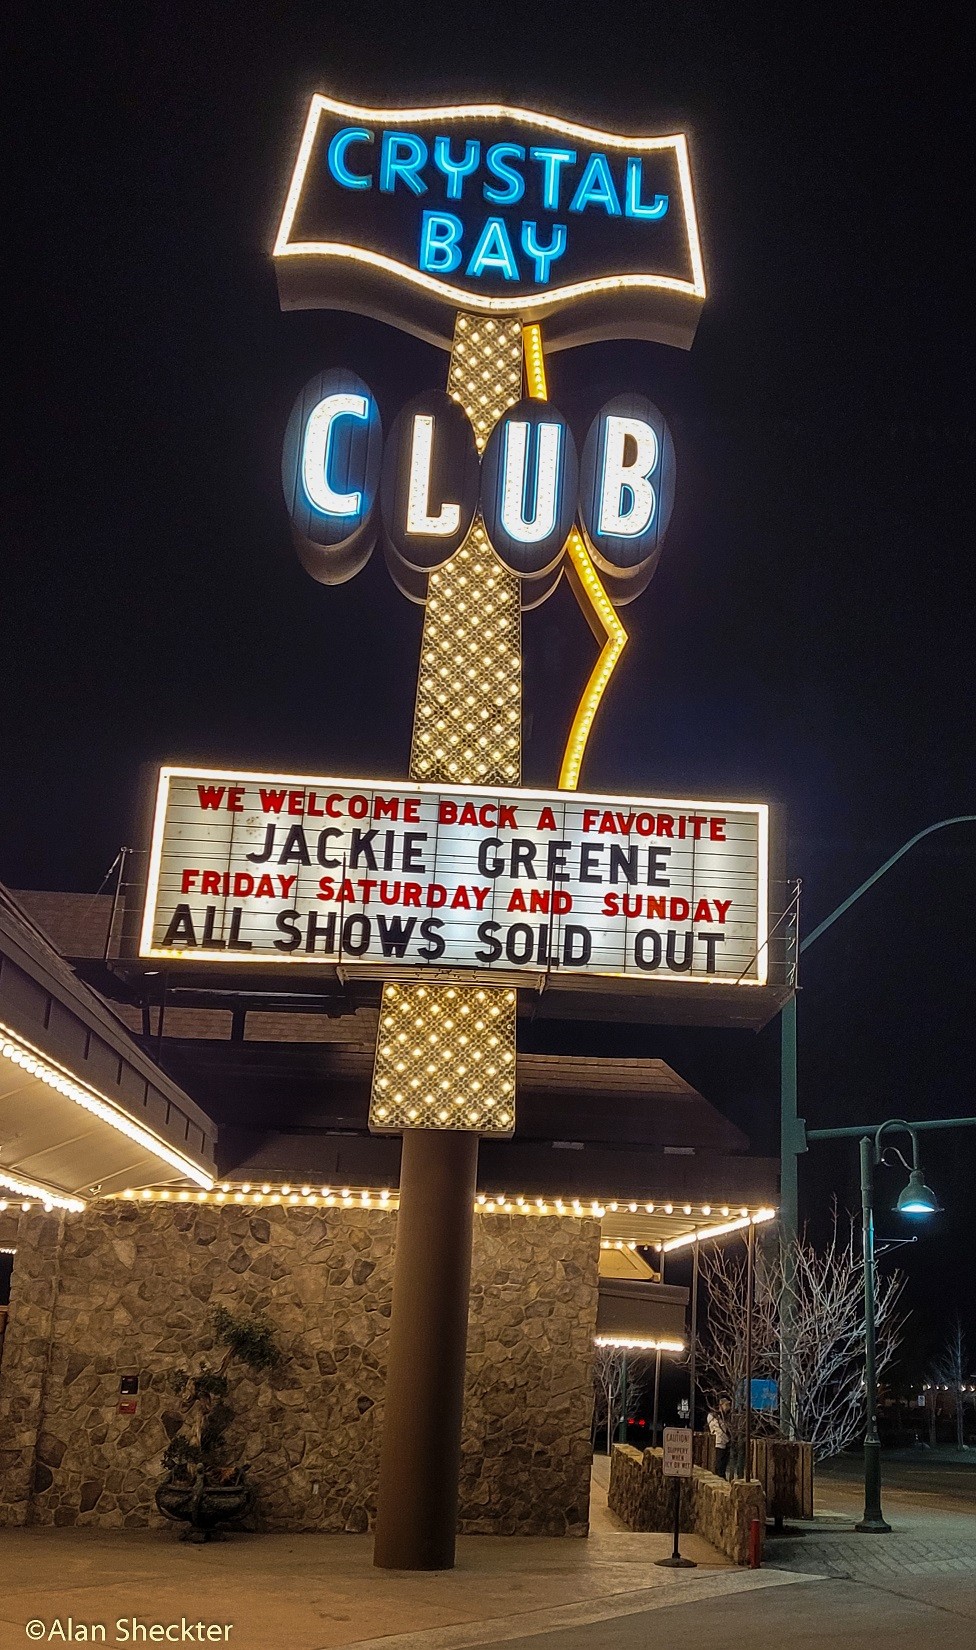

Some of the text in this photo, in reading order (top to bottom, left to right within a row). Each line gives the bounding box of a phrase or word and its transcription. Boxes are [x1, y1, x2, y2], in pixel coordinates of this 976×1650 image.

[327, 127, 668, 220] CRYSTAL
[418, 210, 567, 284] BAY
[301, 393, 658, 543] CLUB
[197, 785, 727, 842] WE WELCOME BACK A FAVORITE
[246, 823, 672, 888] JACKIE GREENE
[180, 868, 733, 924] FRIDAY SATURDAY AND SUNDAY
[161, 903, 725, 974] ALL SHOWS SOLD OUT
